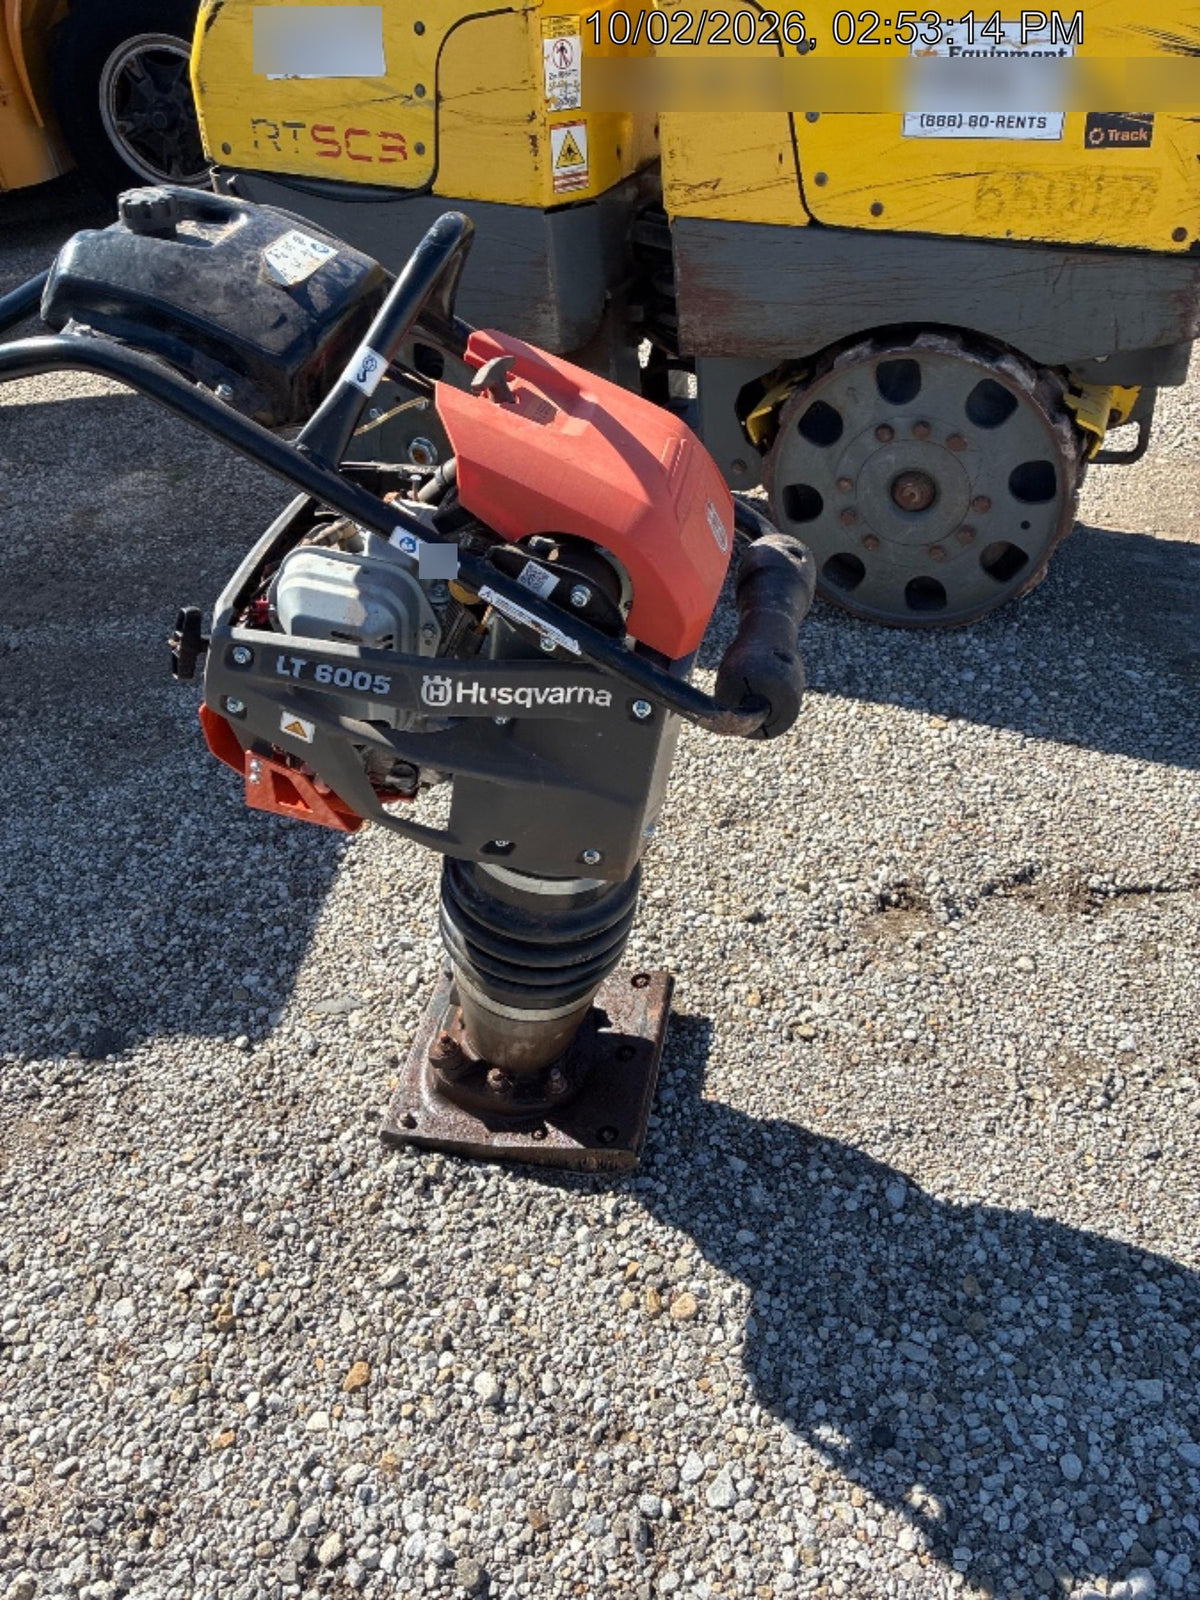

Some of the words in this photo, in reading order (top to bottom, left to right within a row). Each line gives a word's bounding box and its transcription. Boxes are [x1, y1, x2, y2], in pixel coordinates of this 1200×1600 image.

[948, 46, 1068, 58] Equipment
[968, 115, 1048, 129] 80-RENTS
[1107, 128, 1148, 142] Track
[275, 655, 308, 678] LT
[315, 663, 392, 696] 6005
[456, 681, 613, 709] Husqvarna
